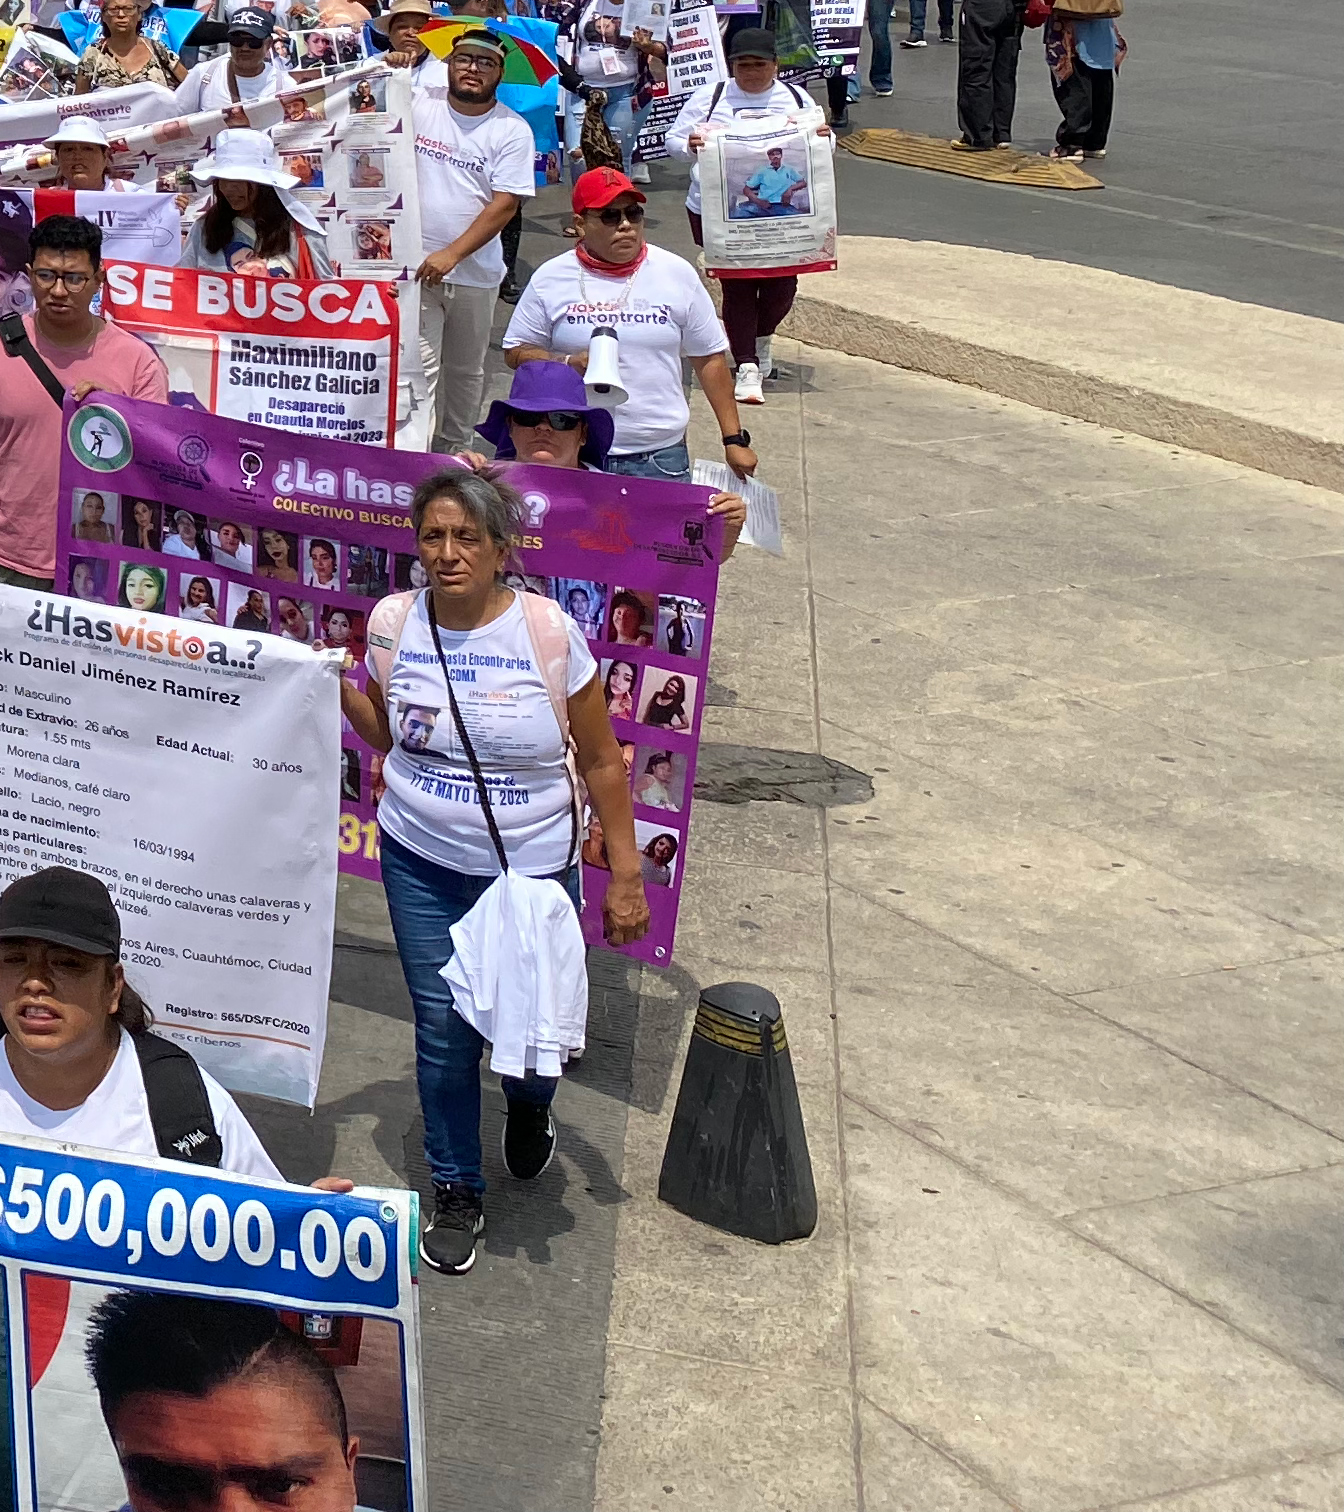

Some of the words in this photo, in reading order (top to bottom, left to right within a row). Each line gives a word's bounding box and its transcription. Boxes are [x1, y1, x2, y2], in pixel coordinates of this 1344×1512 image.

[56, 102, 91, 114] Hasta
[415, 134, 454, 153] Hasta
[414, 144, 484, 172] encontrarte
[107, 264, 174, 311] SE
[197, 274, 391, 325] BUSCA
[230, 339, 377, 372] Maximiliano
[229, 366, 311, 392] Sánchez
[315, 372, 380, 395] Galicia
[268, 396, 345, 416] Desapareció
[247, 412, 262, 424] en
[264, 412, 313, 430] Cuautla
[316, 417, 365, 431] Morelos
[353, 431, 383, 444] 2023
[274, 458, 336, 499] ¿La
[346, 470, 413, 507] has
[273, 497, 354, 521] COLECTIVO
[468, 653, 531, 671] Encontrarles
[19, 650, 76, 675] Daniel
[81, 661, 157, 692] Jiménez
[162, 678, 241, 706] Ramírez
[14, 684, 72, 706] Masculino
[102, 723, 130, 739] años
[7, 744, 50, 765] Morena
[52, 752, 81, 770] clara
[156, 735, 188, 753] Edad
[191, 743, 235, 764] Actual:
[271, 759, 303, 775] años
[102, 788, 131, 803] claro
[421, 778, 432, 795] DE
[434, 780, 470, 804] MAYO
[499, 788, 529, 806] 2020
[67, 800, 101, 818] negro
[30, 812, 101, 839] nacimiento:
[133, 836, 196, 864] 16/03/1994
[119, 884, 172, 908] izquierdo
[237, 906, 279, 923] verdes
[240, 894, 301, 910] calaveras
[182, 948, 265, 971] Cuauhtémoc,
[268, 958, 312, 976] Ciudad
[165, 1003, 218, 1023] Registro:
